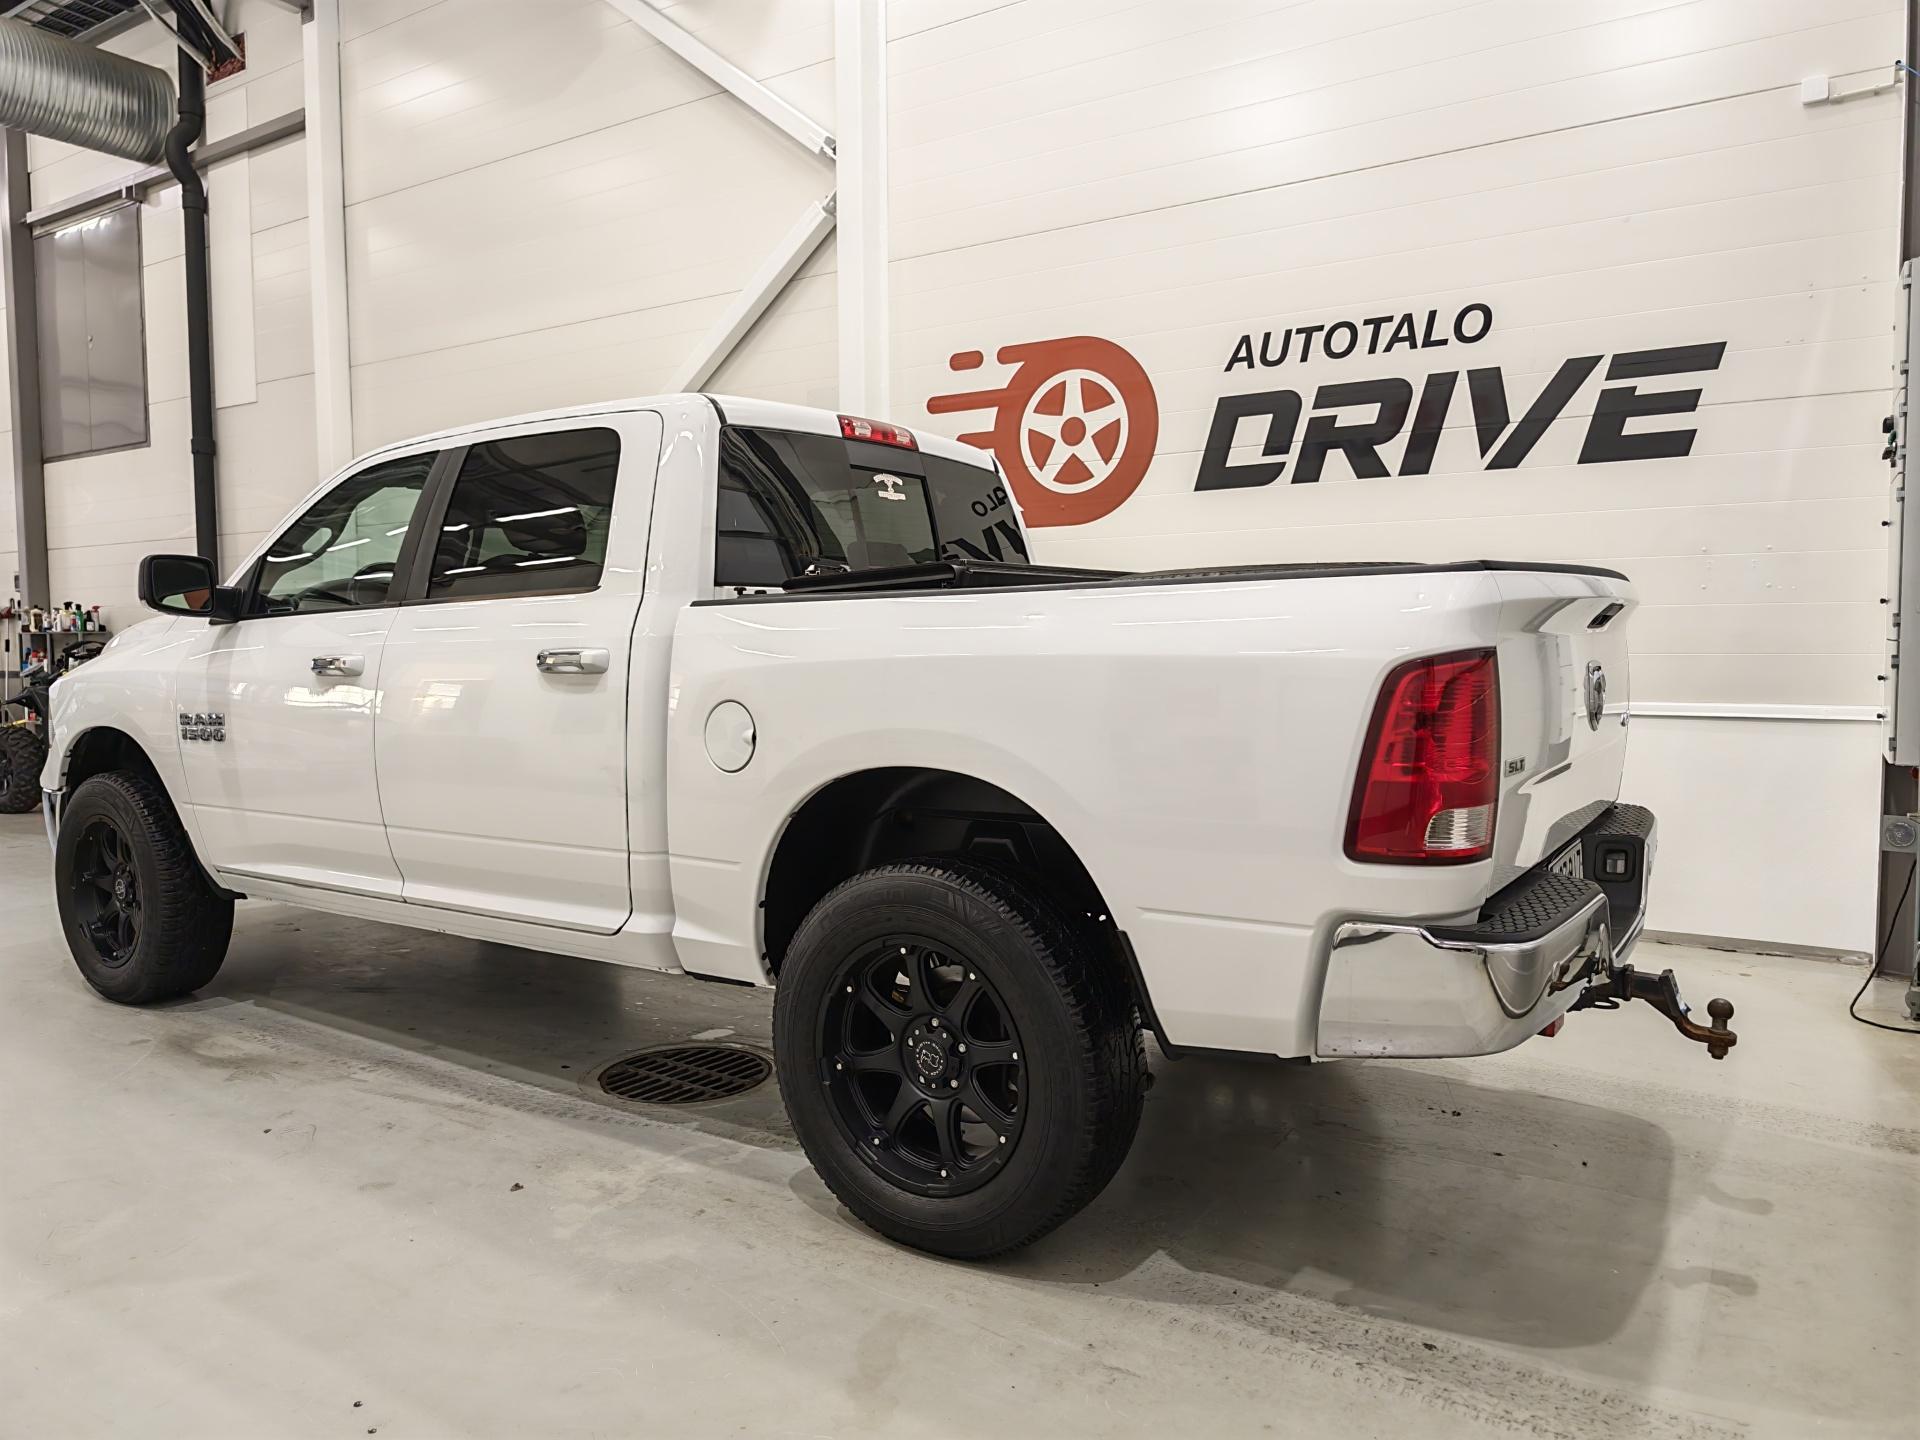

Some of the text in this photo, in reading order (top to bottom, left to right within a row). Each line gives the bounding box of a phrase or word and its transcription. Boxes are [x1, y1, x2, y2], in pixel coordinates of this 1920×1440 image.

[1224, 303, 1493, 373] AUTOTALO
[1193, 341, 1728, 492] DRIVE
[180, 713, 226, 726] RAM
[181, 728, 226, 742] 1500
[1508, 759, 1525, 773] SLT
